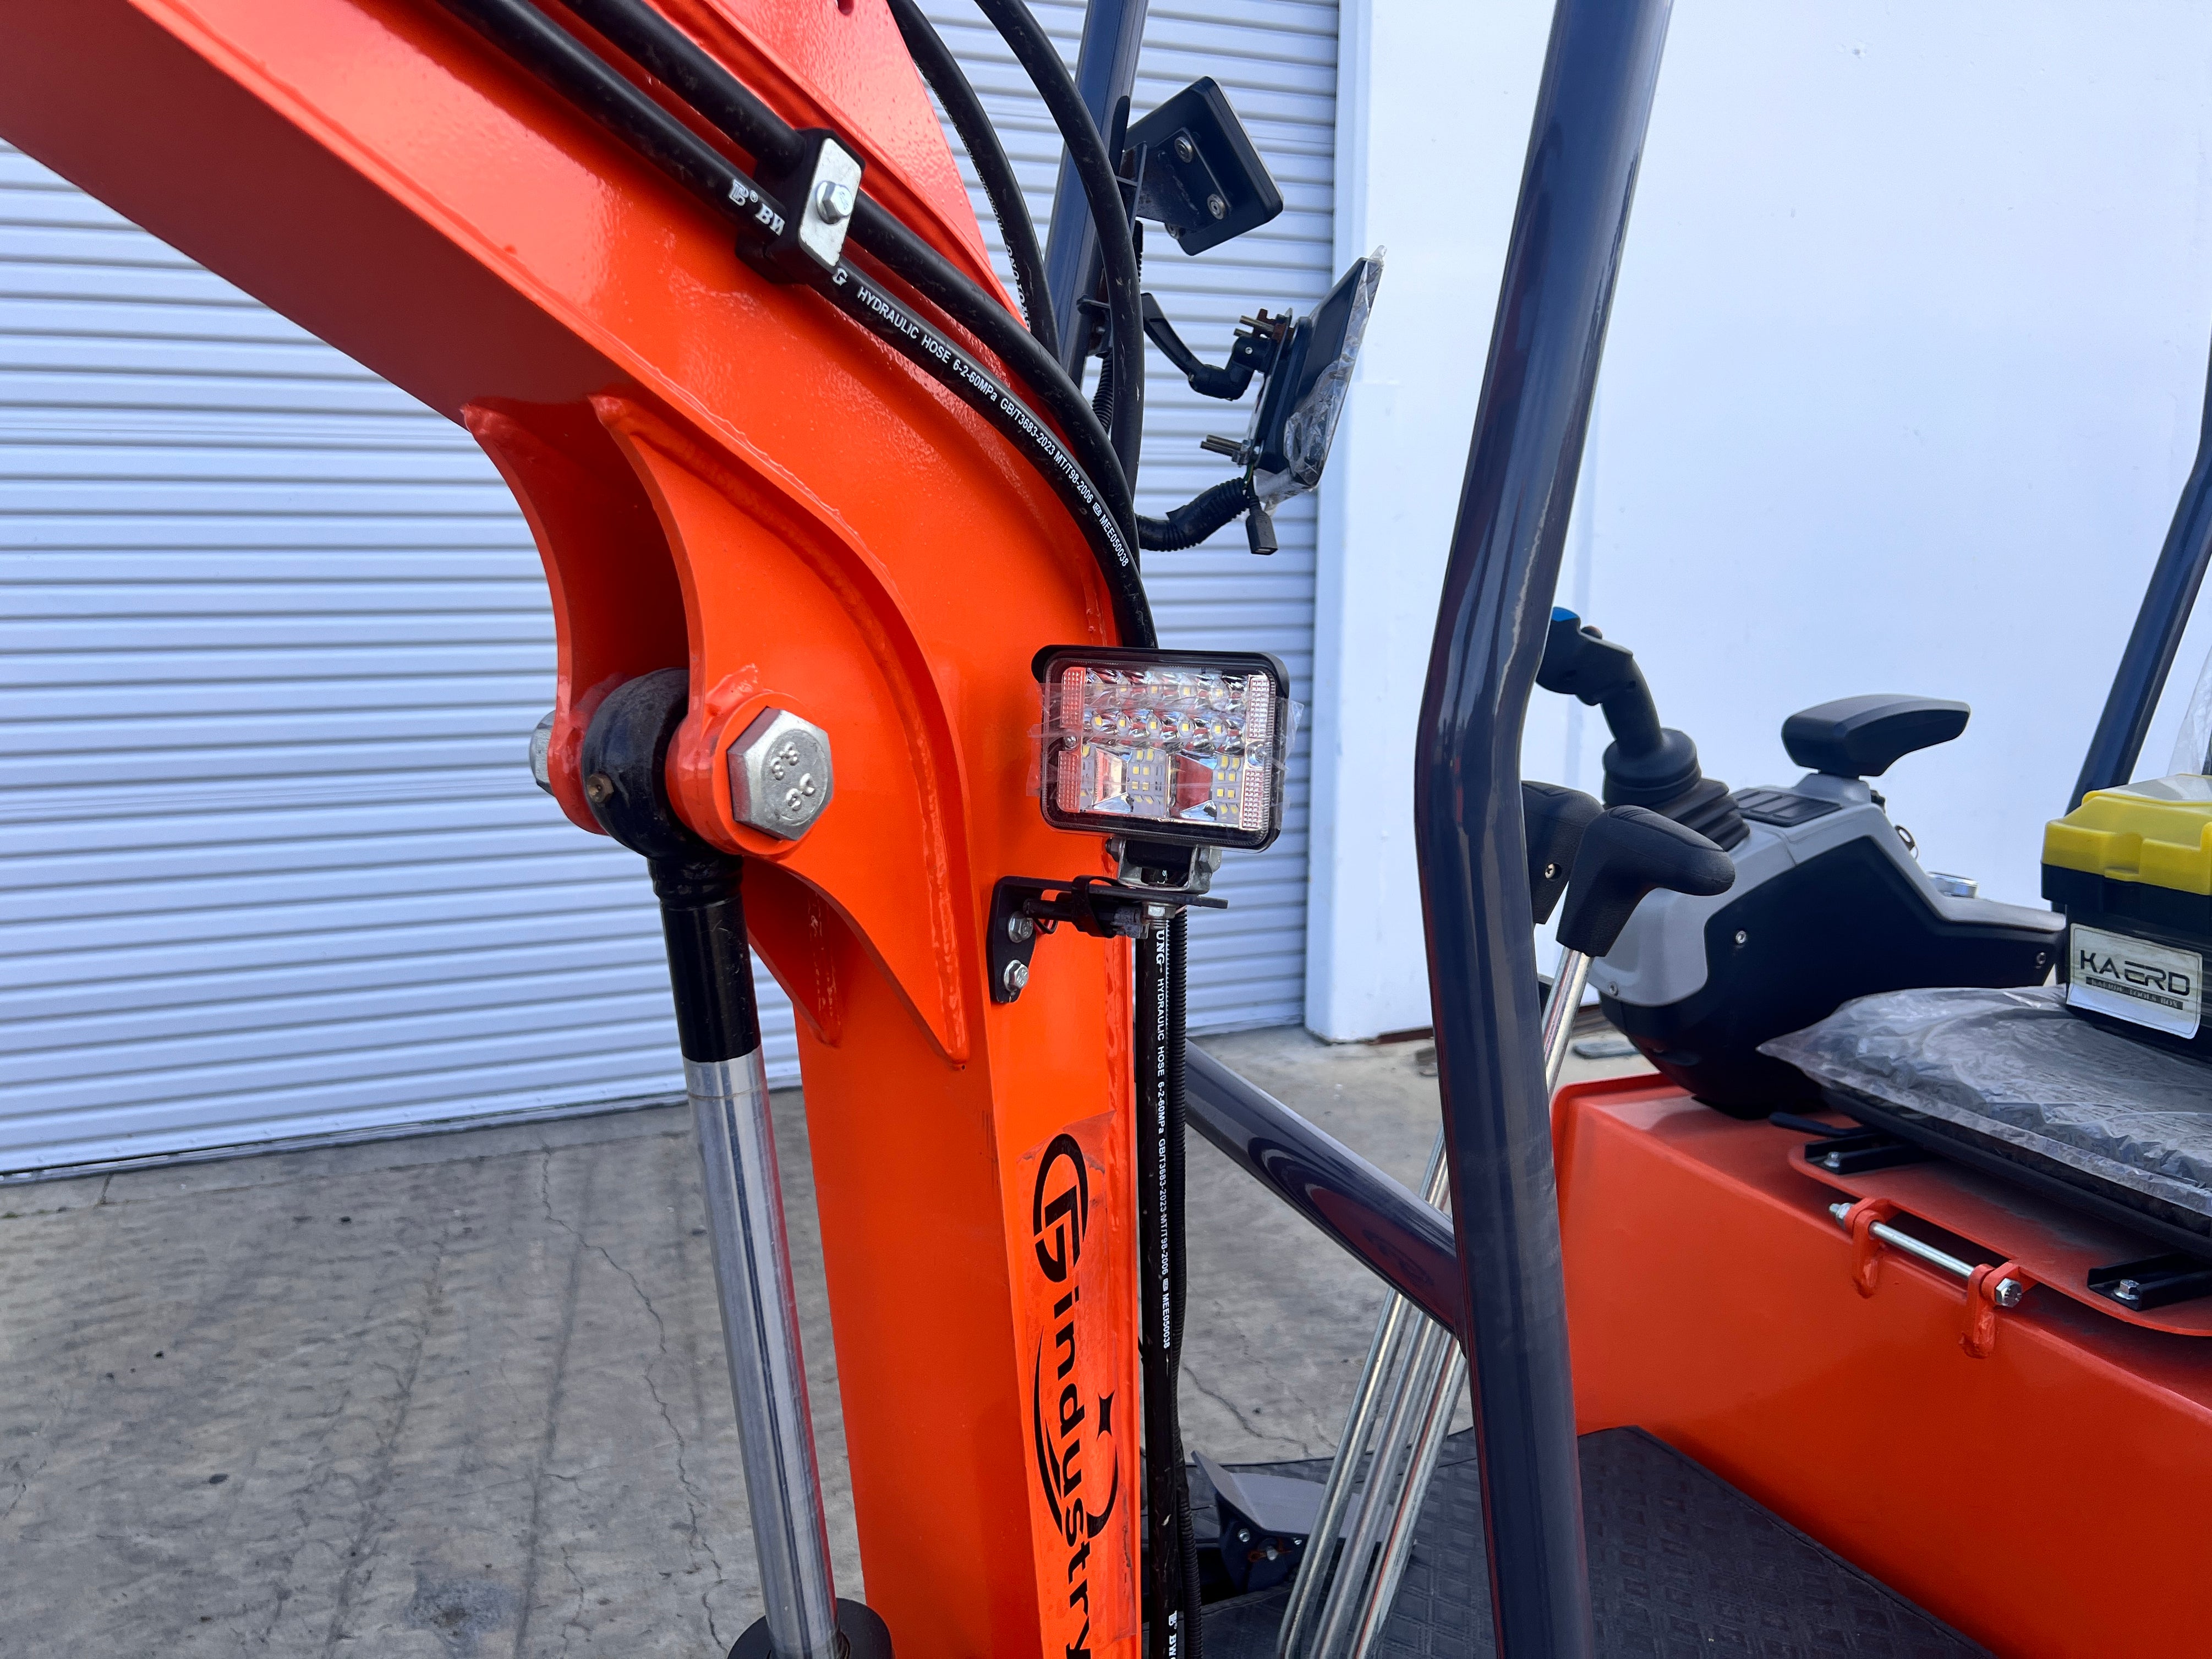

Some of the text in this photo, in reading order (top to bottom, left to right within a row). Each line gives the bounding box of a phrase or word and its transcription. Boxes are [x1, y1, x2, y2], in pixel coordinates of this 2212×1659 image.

[857, 286, 919, 339] HYDRAULIC
[921, 335, 951, 364] HOSE
[953, 359, 998, 402] 6-2-60MPa
[1000, 398, 1055, 455] GB/T3683-2023
[1054, 451, 1094, 503] MT/T98-2006
[1099, 514, 1129, 567] MEE050038
[2080, 950, 2190, 996] KAERD
[1157, 1047, 1165, 1077] HOSE
[1158, 1082, 1166, 1135] 6-2-60MPa
[1158, 1138, 1167, 1213] GB/T3683-2023
[1162, 1293, 1170, 1349] MEE050038
